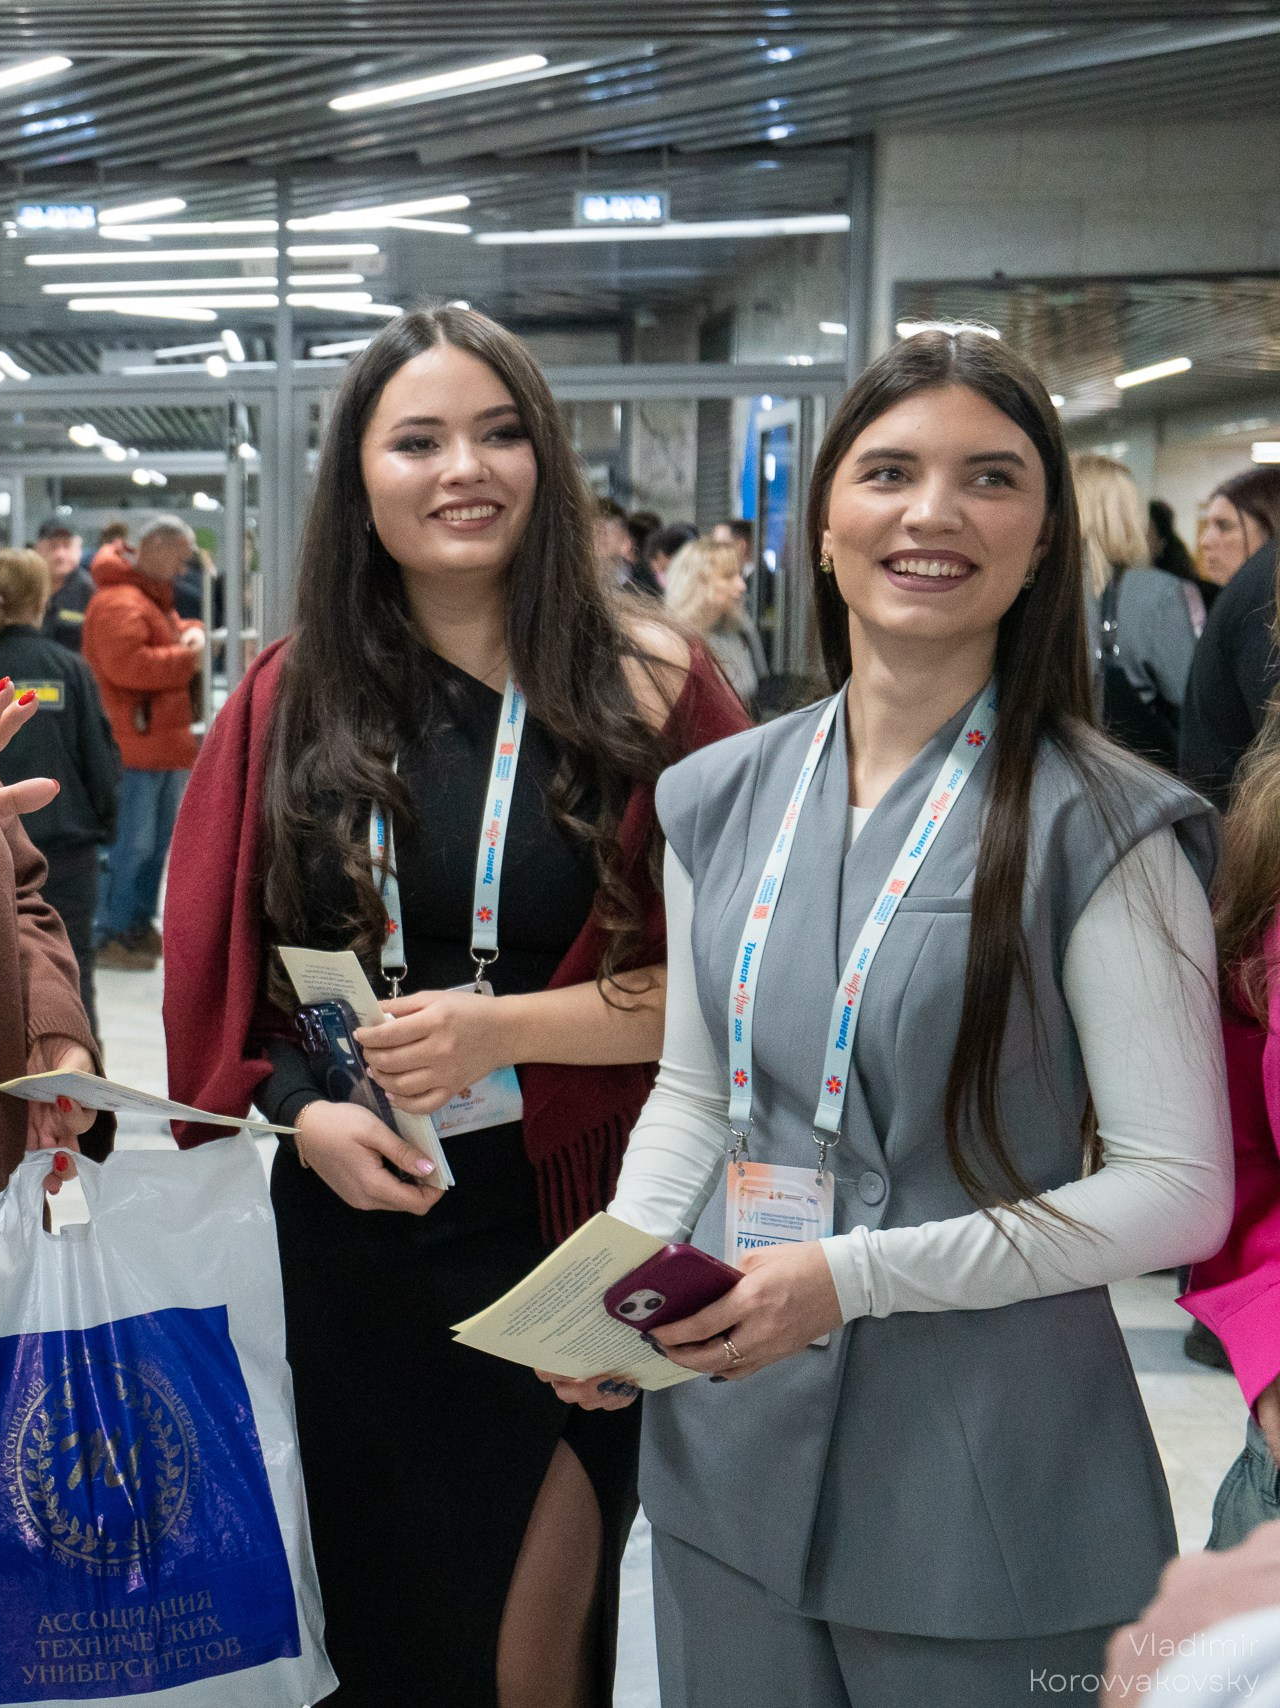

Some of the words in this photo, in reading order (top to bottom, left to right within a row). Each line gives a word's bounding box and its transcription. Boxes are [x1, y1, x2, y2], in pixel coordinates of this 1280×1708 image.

[947, 768, 963, 790] 2025
[493, 799, 503, 818] 2025
[856, 947, 870, 970] 2025
[734, 1019, 742, 1042] 2025
[37, 1589, 213, 1634] АССОЦИАЦИЯ
[21, 1636, 242, 1685] УНИВЕРСИТЕТОВ
